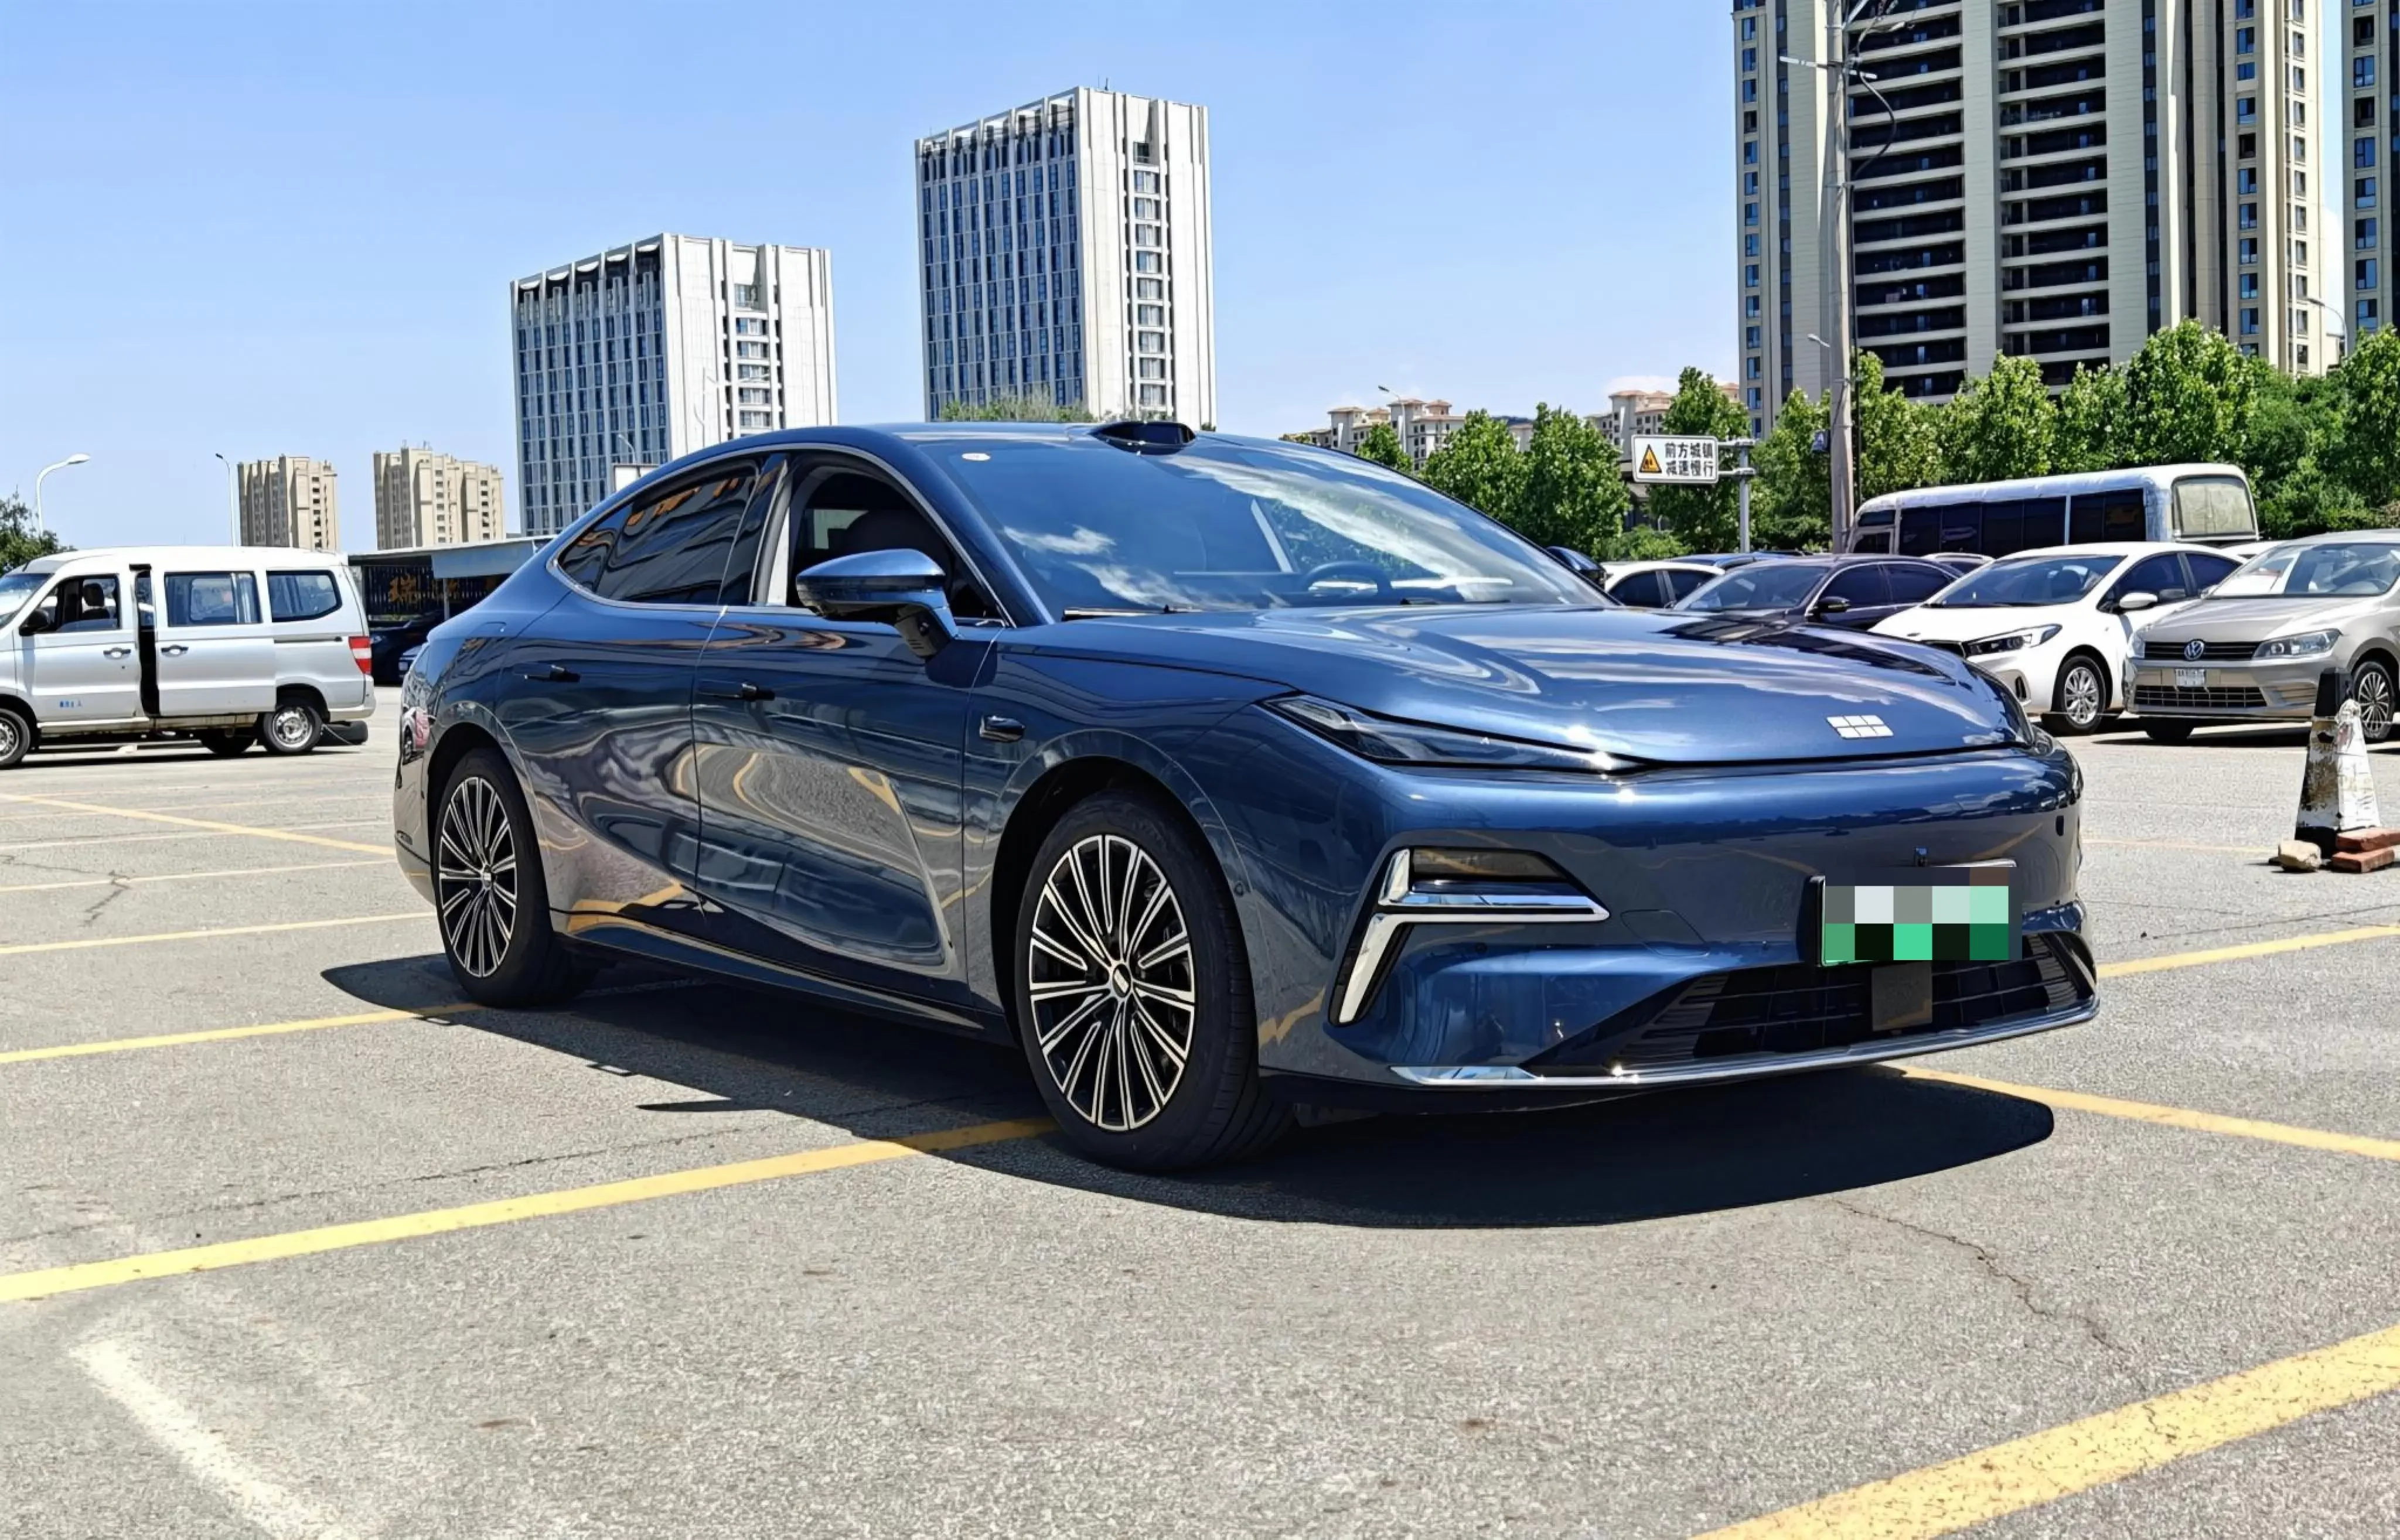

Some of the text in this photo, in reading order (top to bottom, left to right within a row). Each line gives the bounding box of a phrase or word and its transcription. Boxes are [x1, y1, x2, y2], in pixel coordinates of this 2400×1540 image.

[1665, 442, 1713, 459] 前方城镇
[1666, 460, 1714, 477] 减速慢行
